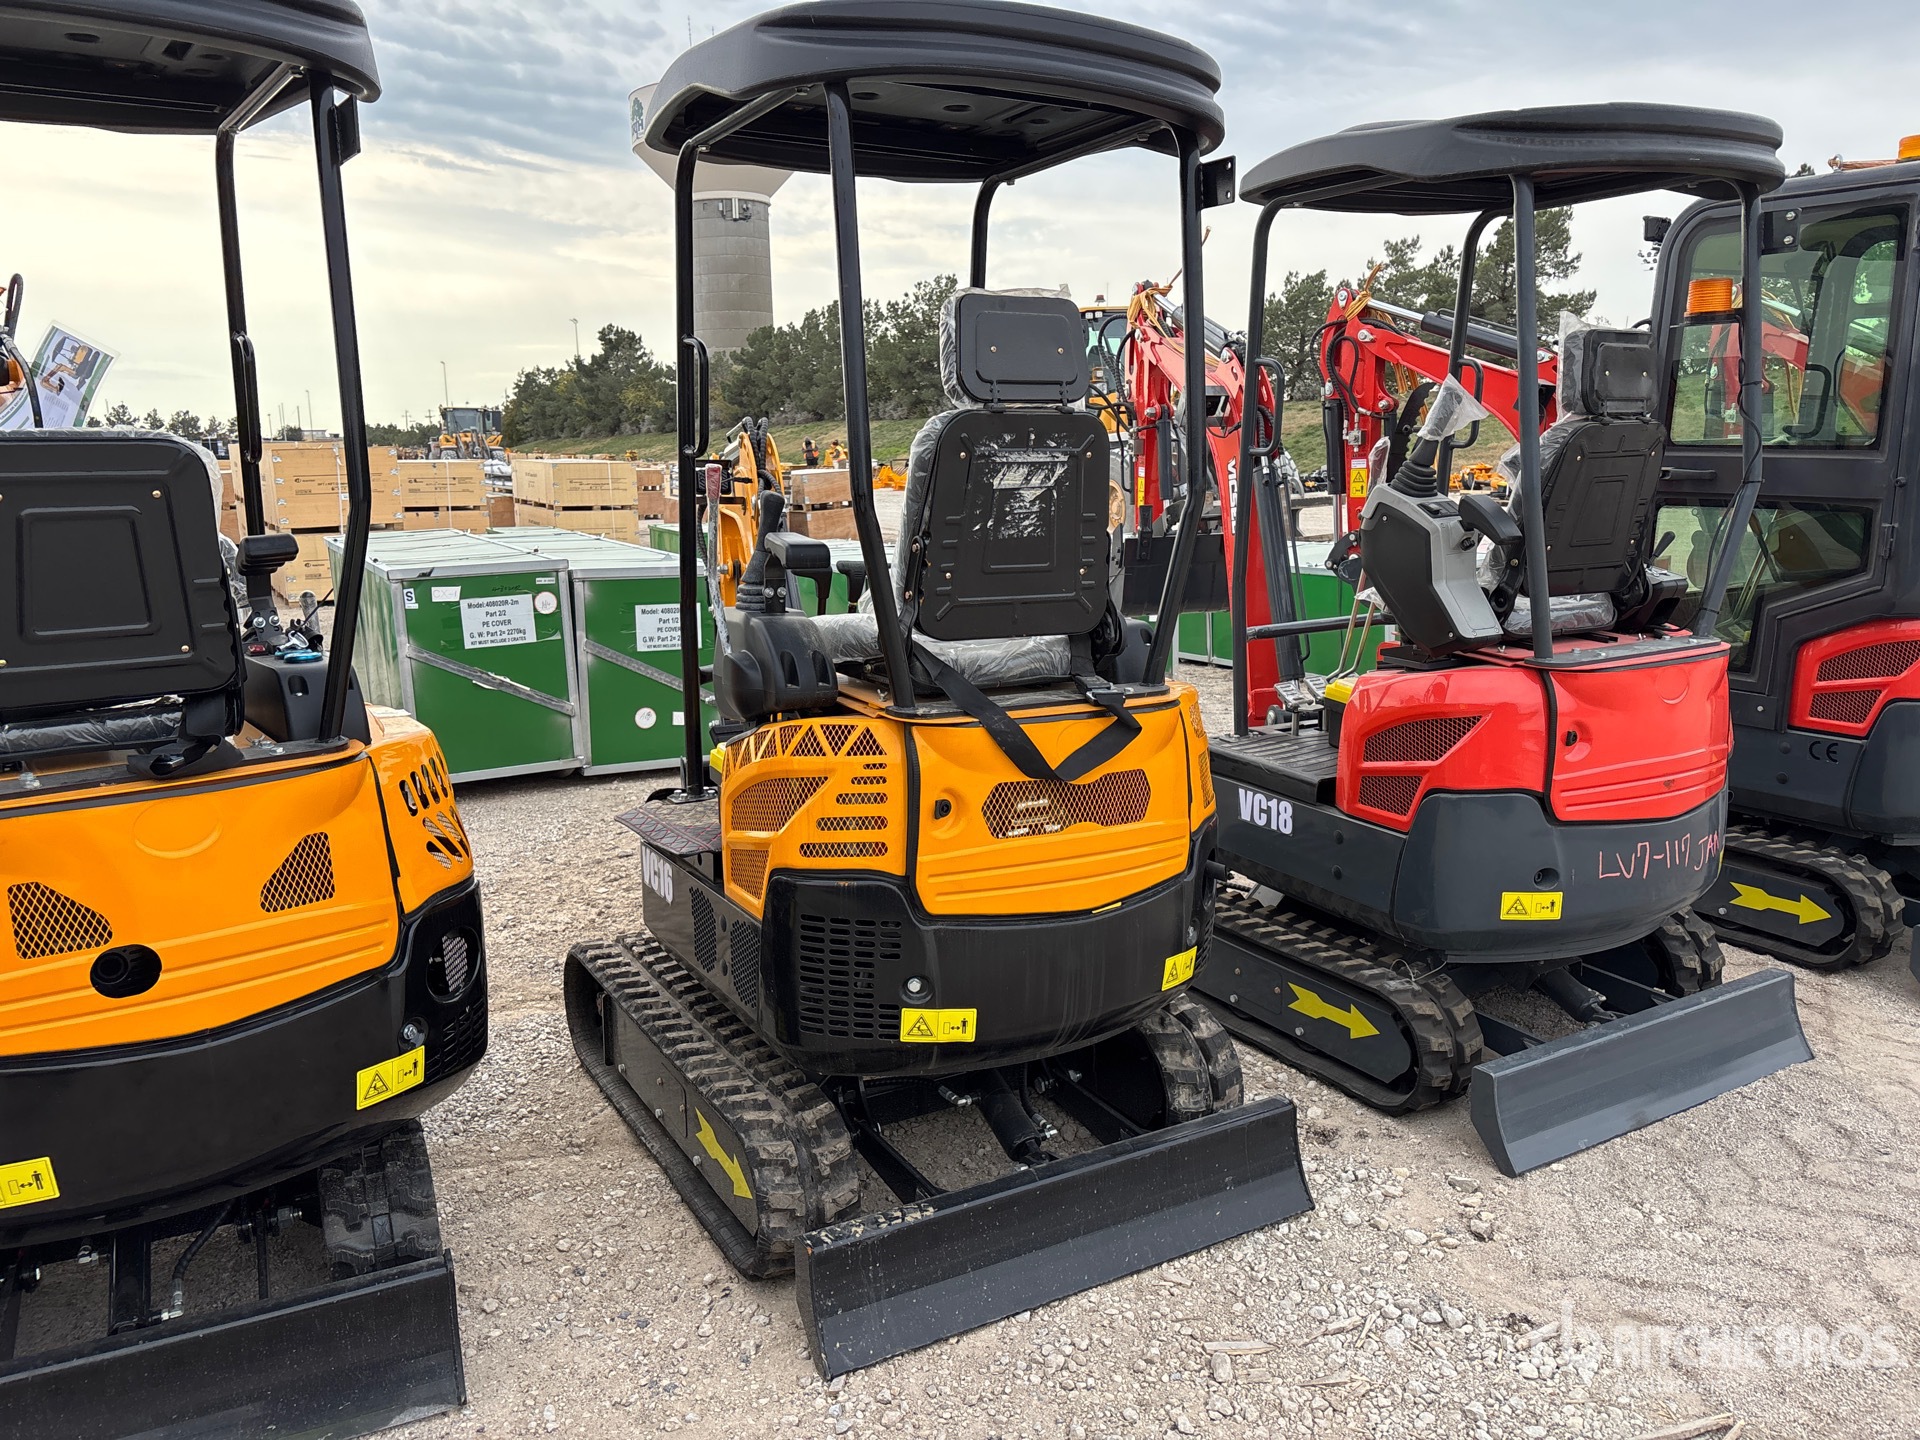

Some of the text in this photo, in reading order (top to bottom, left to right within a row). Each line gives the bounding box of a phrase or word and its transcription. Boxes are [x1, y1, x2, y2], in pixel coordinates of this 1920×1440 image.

[405, 590, 414, 602] S
[485, 609, 507, 618] Part 2/2
[482, 618, 512, 628] PE COVER
[1238, 787, 1293, 835] VC18
